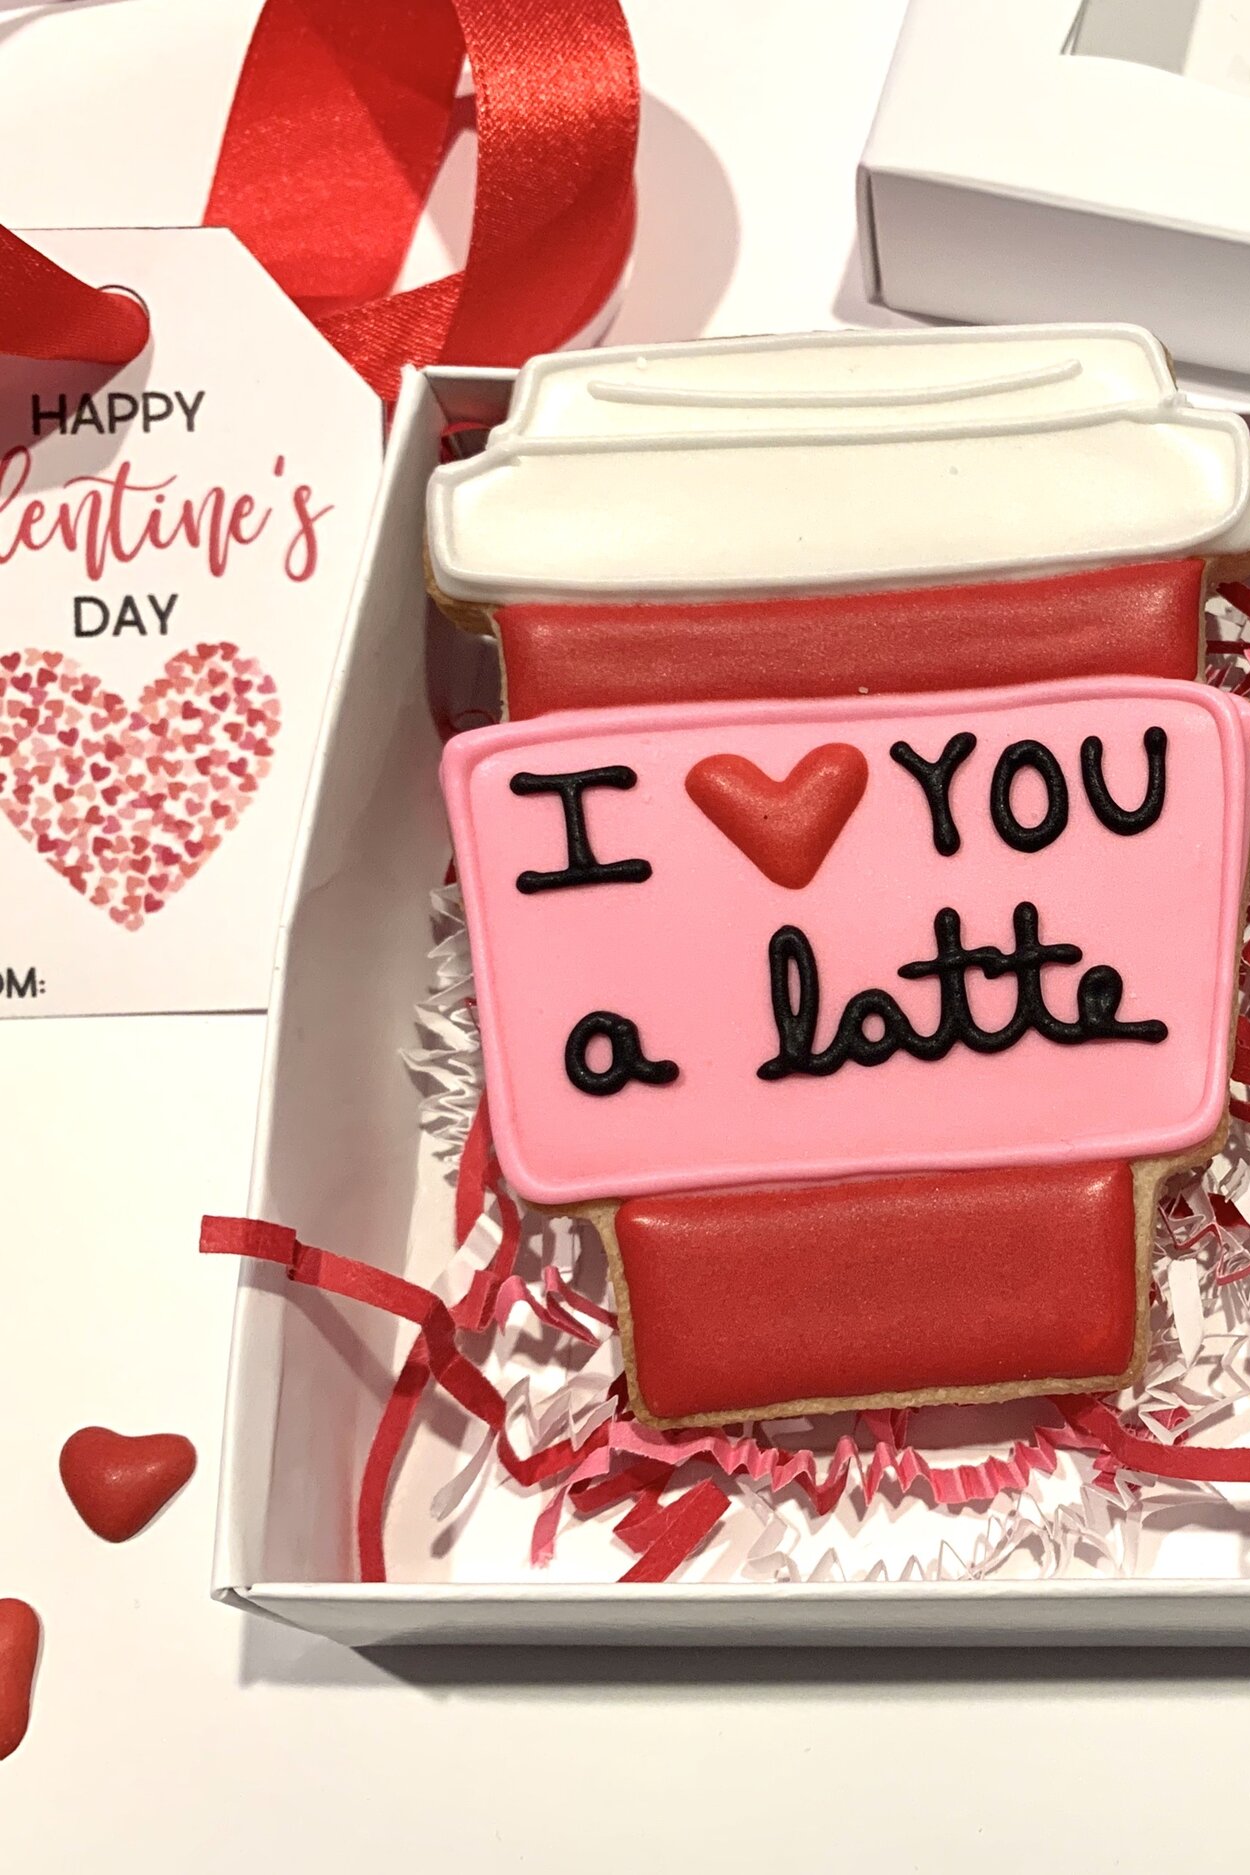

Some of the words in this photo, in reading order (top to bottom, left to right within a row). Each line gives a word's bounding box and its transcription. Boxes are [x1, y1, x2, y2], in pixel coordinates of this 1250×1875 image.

[31, 390, 206, 436] HAPPY
[73, 593, 179, 638] DAY
[509, 764, 652, 895] I
[888, 725, 1168, 857] YOU
[564, 1010, 680, 1097] a
[756, 901, 1169, 1081] latte
